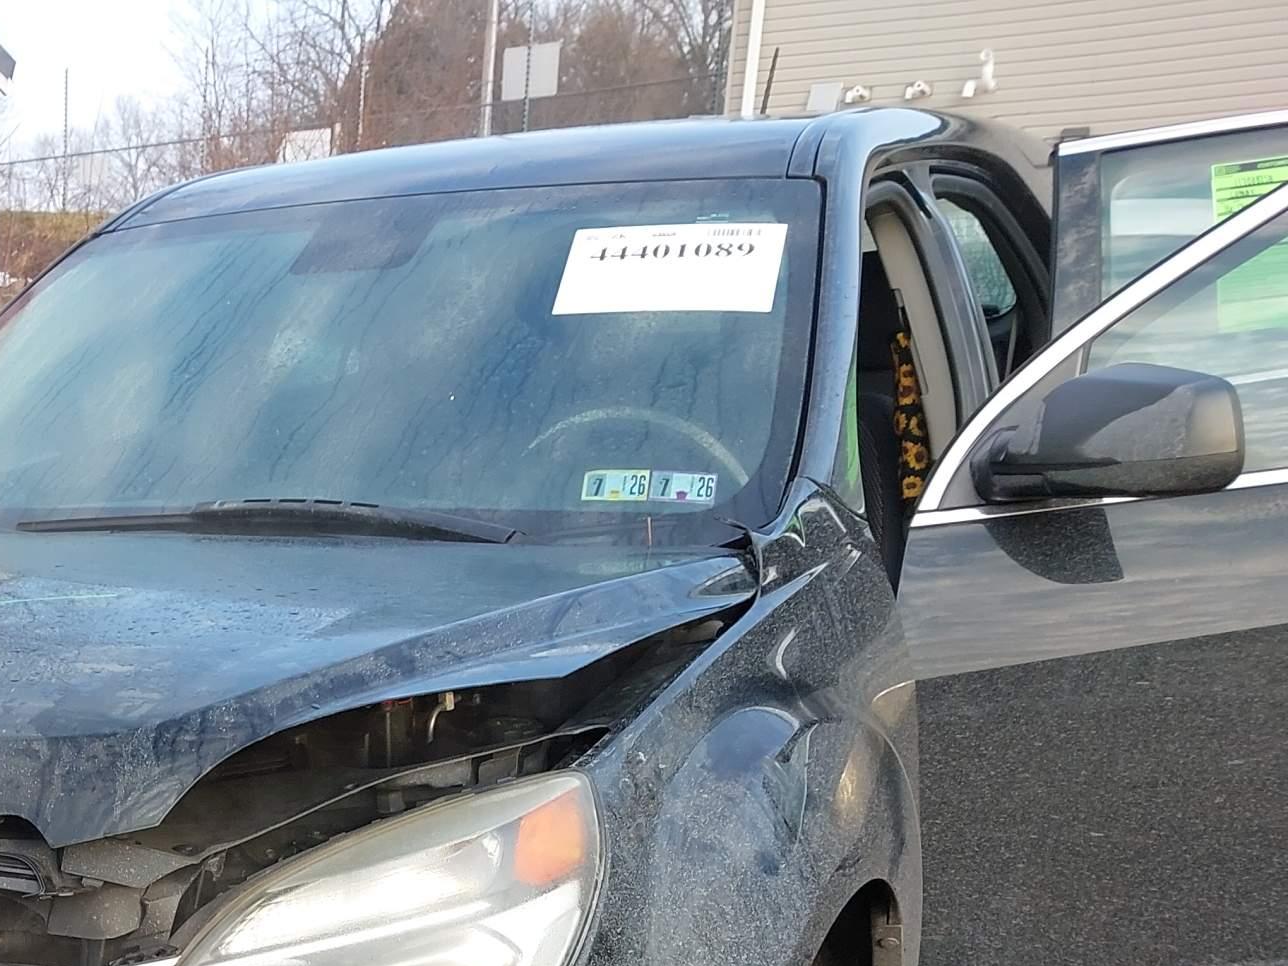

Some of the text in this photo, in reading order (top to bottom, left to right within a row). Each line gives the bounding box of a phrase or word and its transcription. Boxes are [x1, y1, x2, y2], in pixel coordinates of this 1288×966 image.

[589, 243, 756, 261] 44401089
[593, 474, 646, 496] 7 26
[659, 476, 714, 498] 7 26
